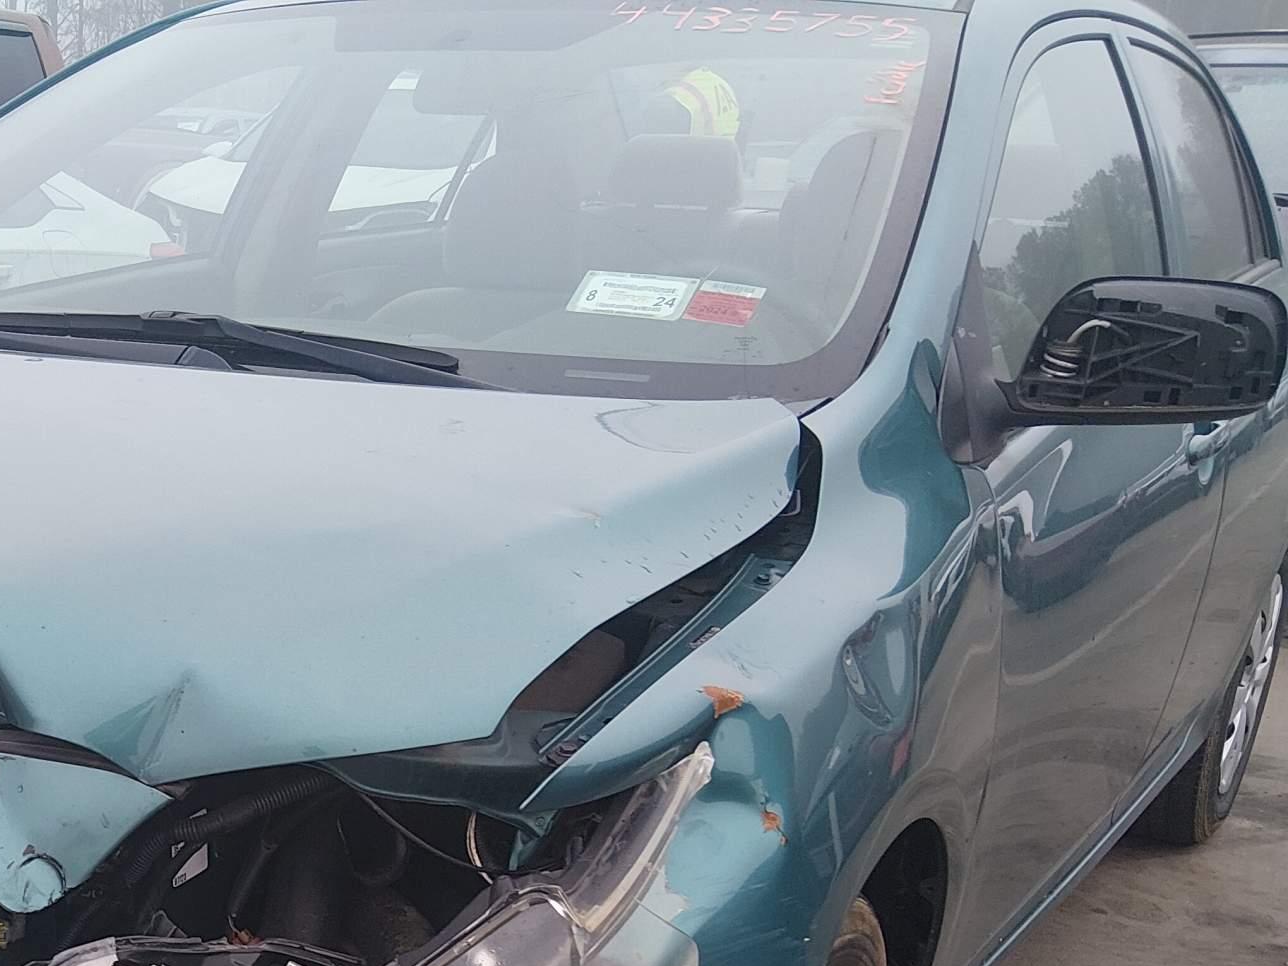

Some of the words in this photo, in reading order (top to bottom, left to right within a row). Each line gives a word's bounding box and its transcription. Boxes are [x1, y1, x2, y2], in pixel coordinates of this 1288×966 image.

[611, 2, 917, 41] 44335755
[585, 289, 598, 302] 8
[652, 296, 677, 309] 24
